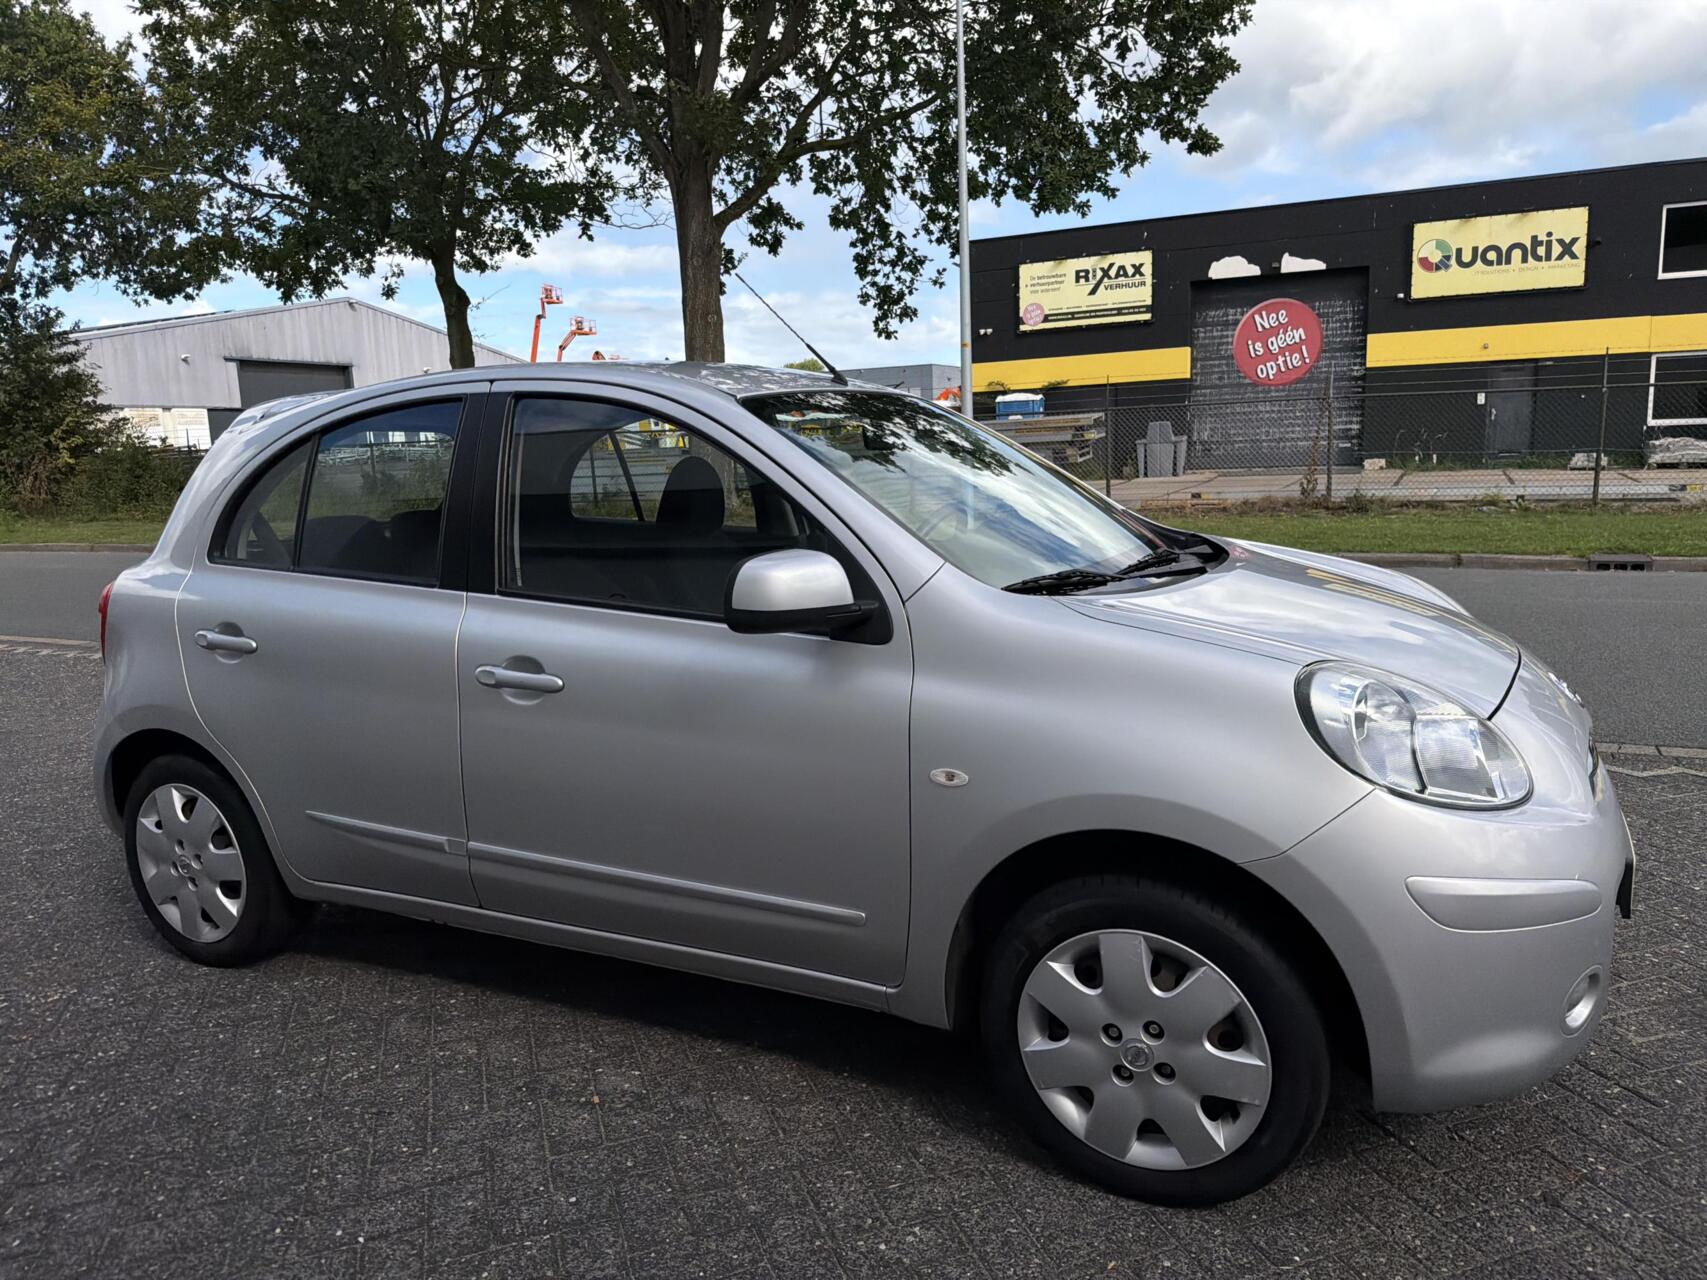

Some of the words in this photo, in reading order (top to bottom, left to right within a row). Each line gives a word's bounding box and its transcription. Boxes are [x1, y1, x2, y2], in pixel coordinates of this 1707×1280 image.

[1103, 281, 1146, 291] VERHUUR
[1254, 309, 1288, 332] Nee
[1248, 340, 1264, 358] is
[1267, 326, 1306, 354] géén
